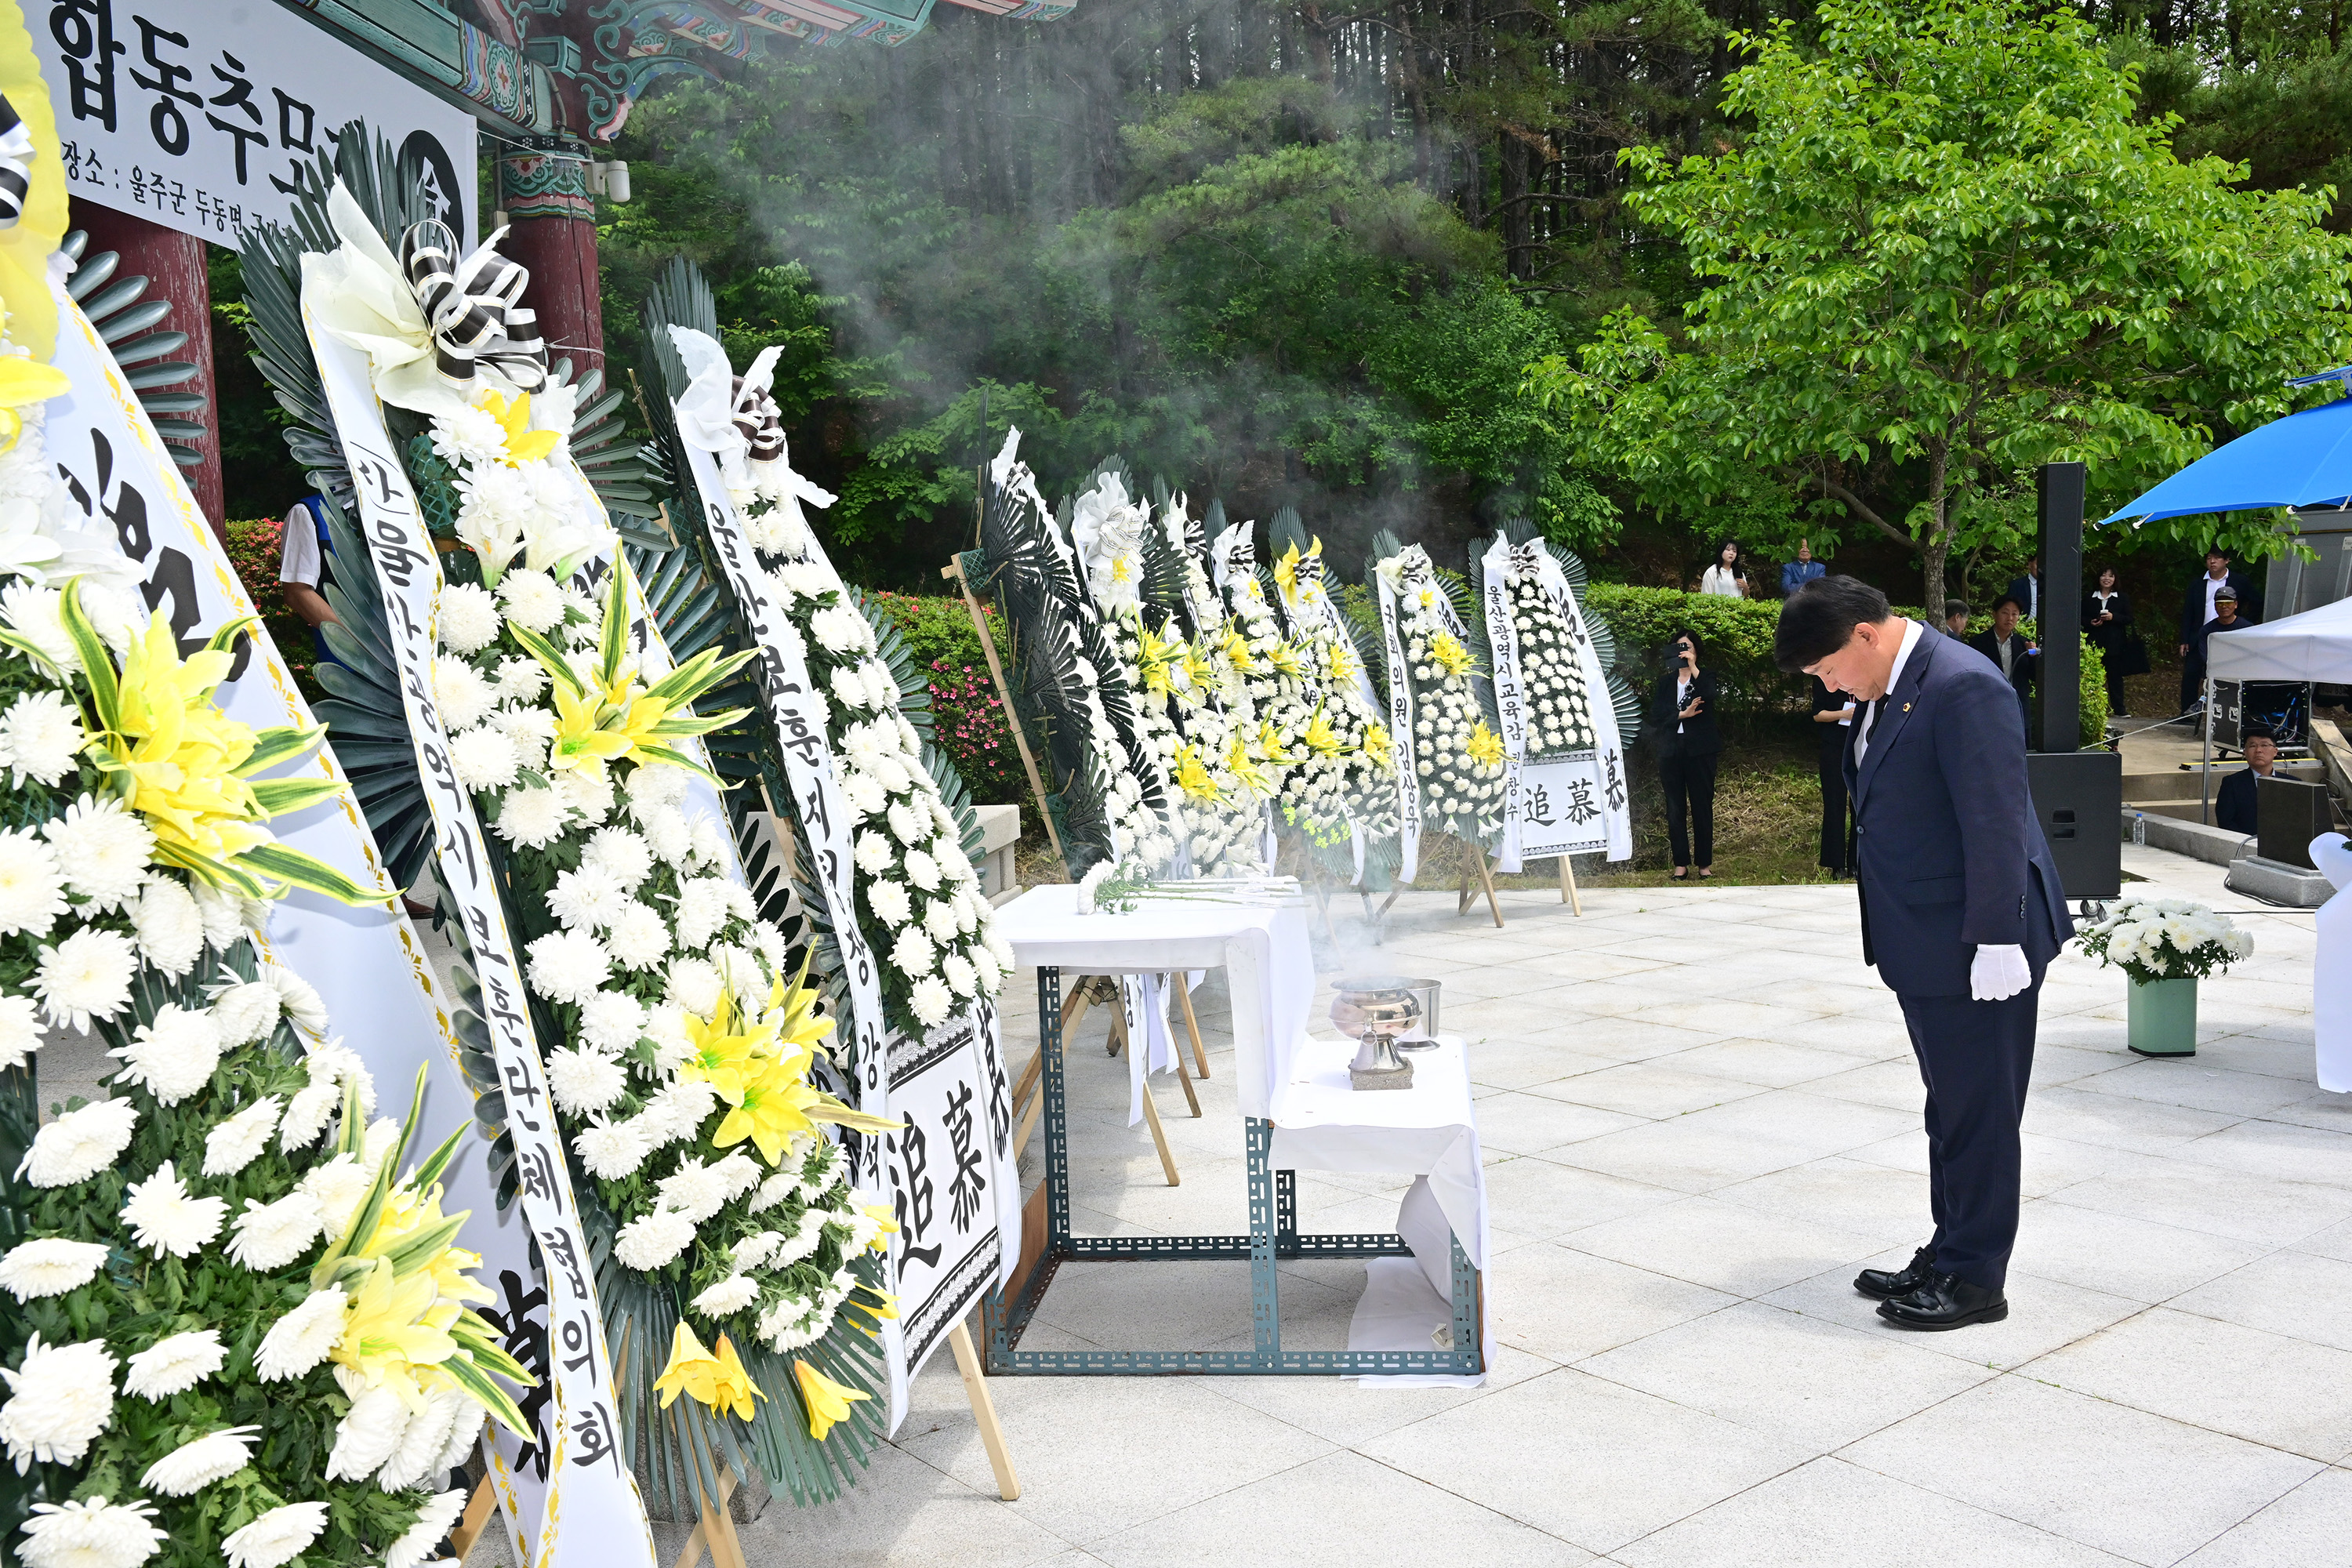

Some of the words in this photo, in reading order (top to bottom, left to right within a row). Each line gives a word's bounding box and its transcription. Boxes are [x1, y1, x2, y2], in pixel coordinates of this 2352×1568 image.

[49, 0, 365, 204] 합동추모
[129, 165, 187, 216] 울주군
[195, 189, 244, 238] 두동면
[1384, 604, 1407, 728] 국회의원
[1398, 740, 1420, 838] 김상욱
[1487, 586, 1524, 741] 울산광역시교육감
[1523, 778, 1602, 827] 追慕
[1605, 748, 1625, 812] 慕
[887, 1080, 986, 1284] 追慕
